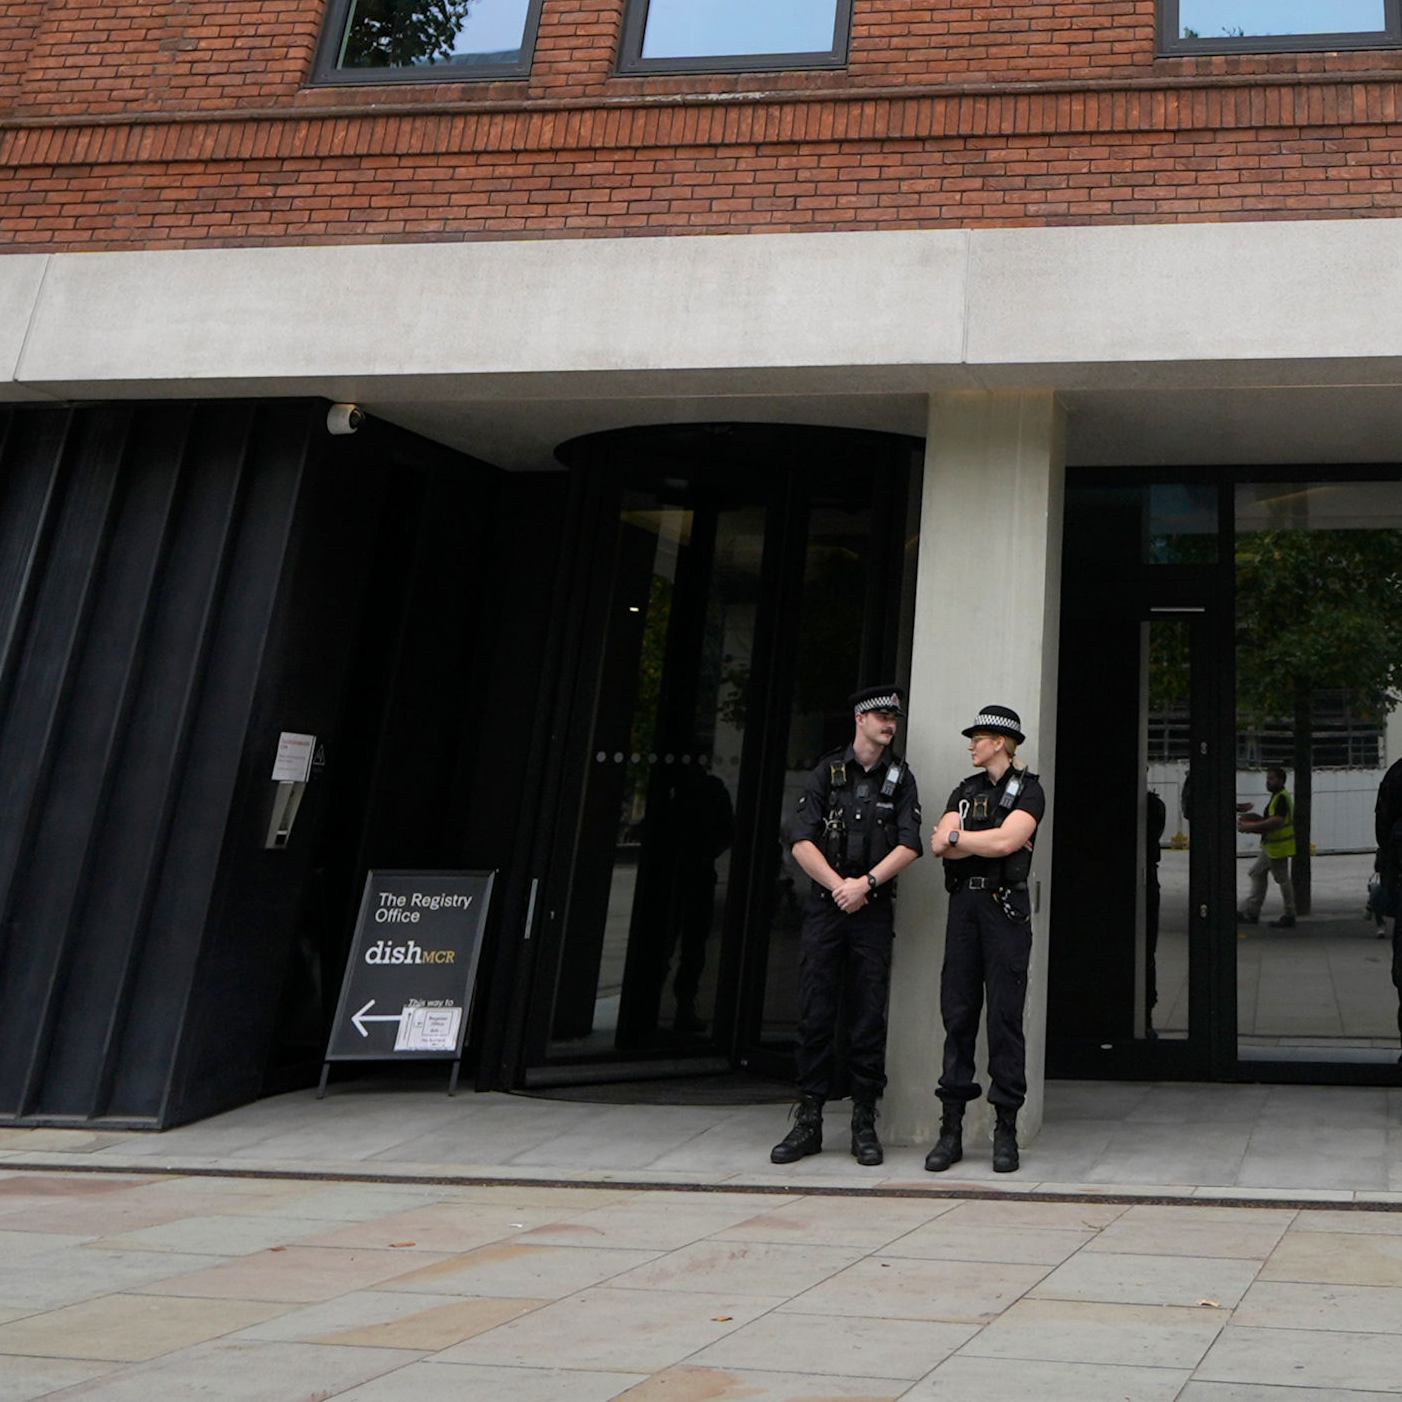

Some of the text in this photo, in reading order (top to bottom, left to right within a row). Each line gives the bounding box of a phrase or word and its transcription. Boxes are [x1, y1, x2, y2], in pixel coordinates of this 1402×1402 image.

[379, 892, 473, 910] The Registry
[375, 908, 421, 923] Office
[408, 998, 427, 1007] This
[445, 998, 454, 1007] to
